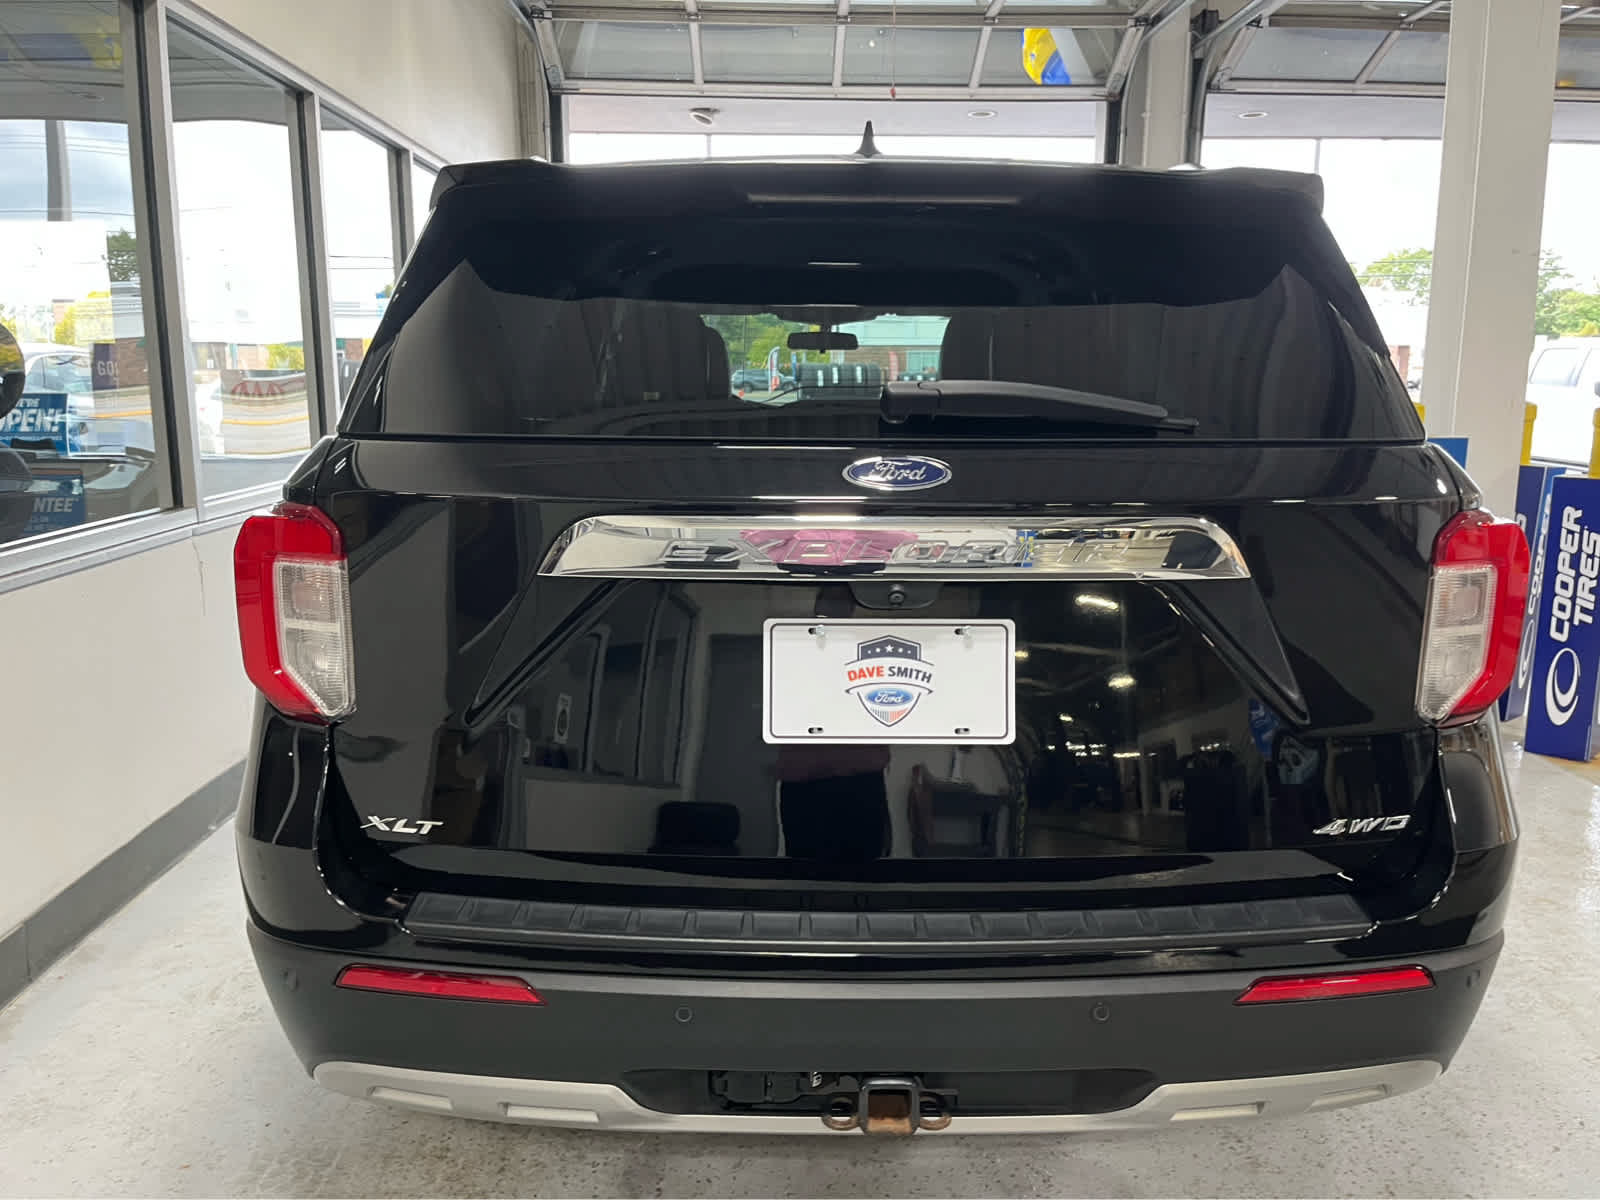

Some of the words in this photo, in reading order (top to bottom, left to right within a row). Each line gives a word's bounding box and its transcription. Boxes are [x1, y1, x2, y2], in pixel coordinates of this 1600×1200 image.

[869, 460, 926, 480] Ford
[658, 538, 1131, 562] EXPLORER
[1550, 506, 1583, 643] COOPER
[1573, 530, 1600, 626] TIRES
[847, 666, 885, 682] DAVE
[887, 666, 932, 683] SMITH
[874, 691, 904, 703] Ford
[360, 816, 444, 835] XLT
[1312, 814, 1411, 836] 4WD
